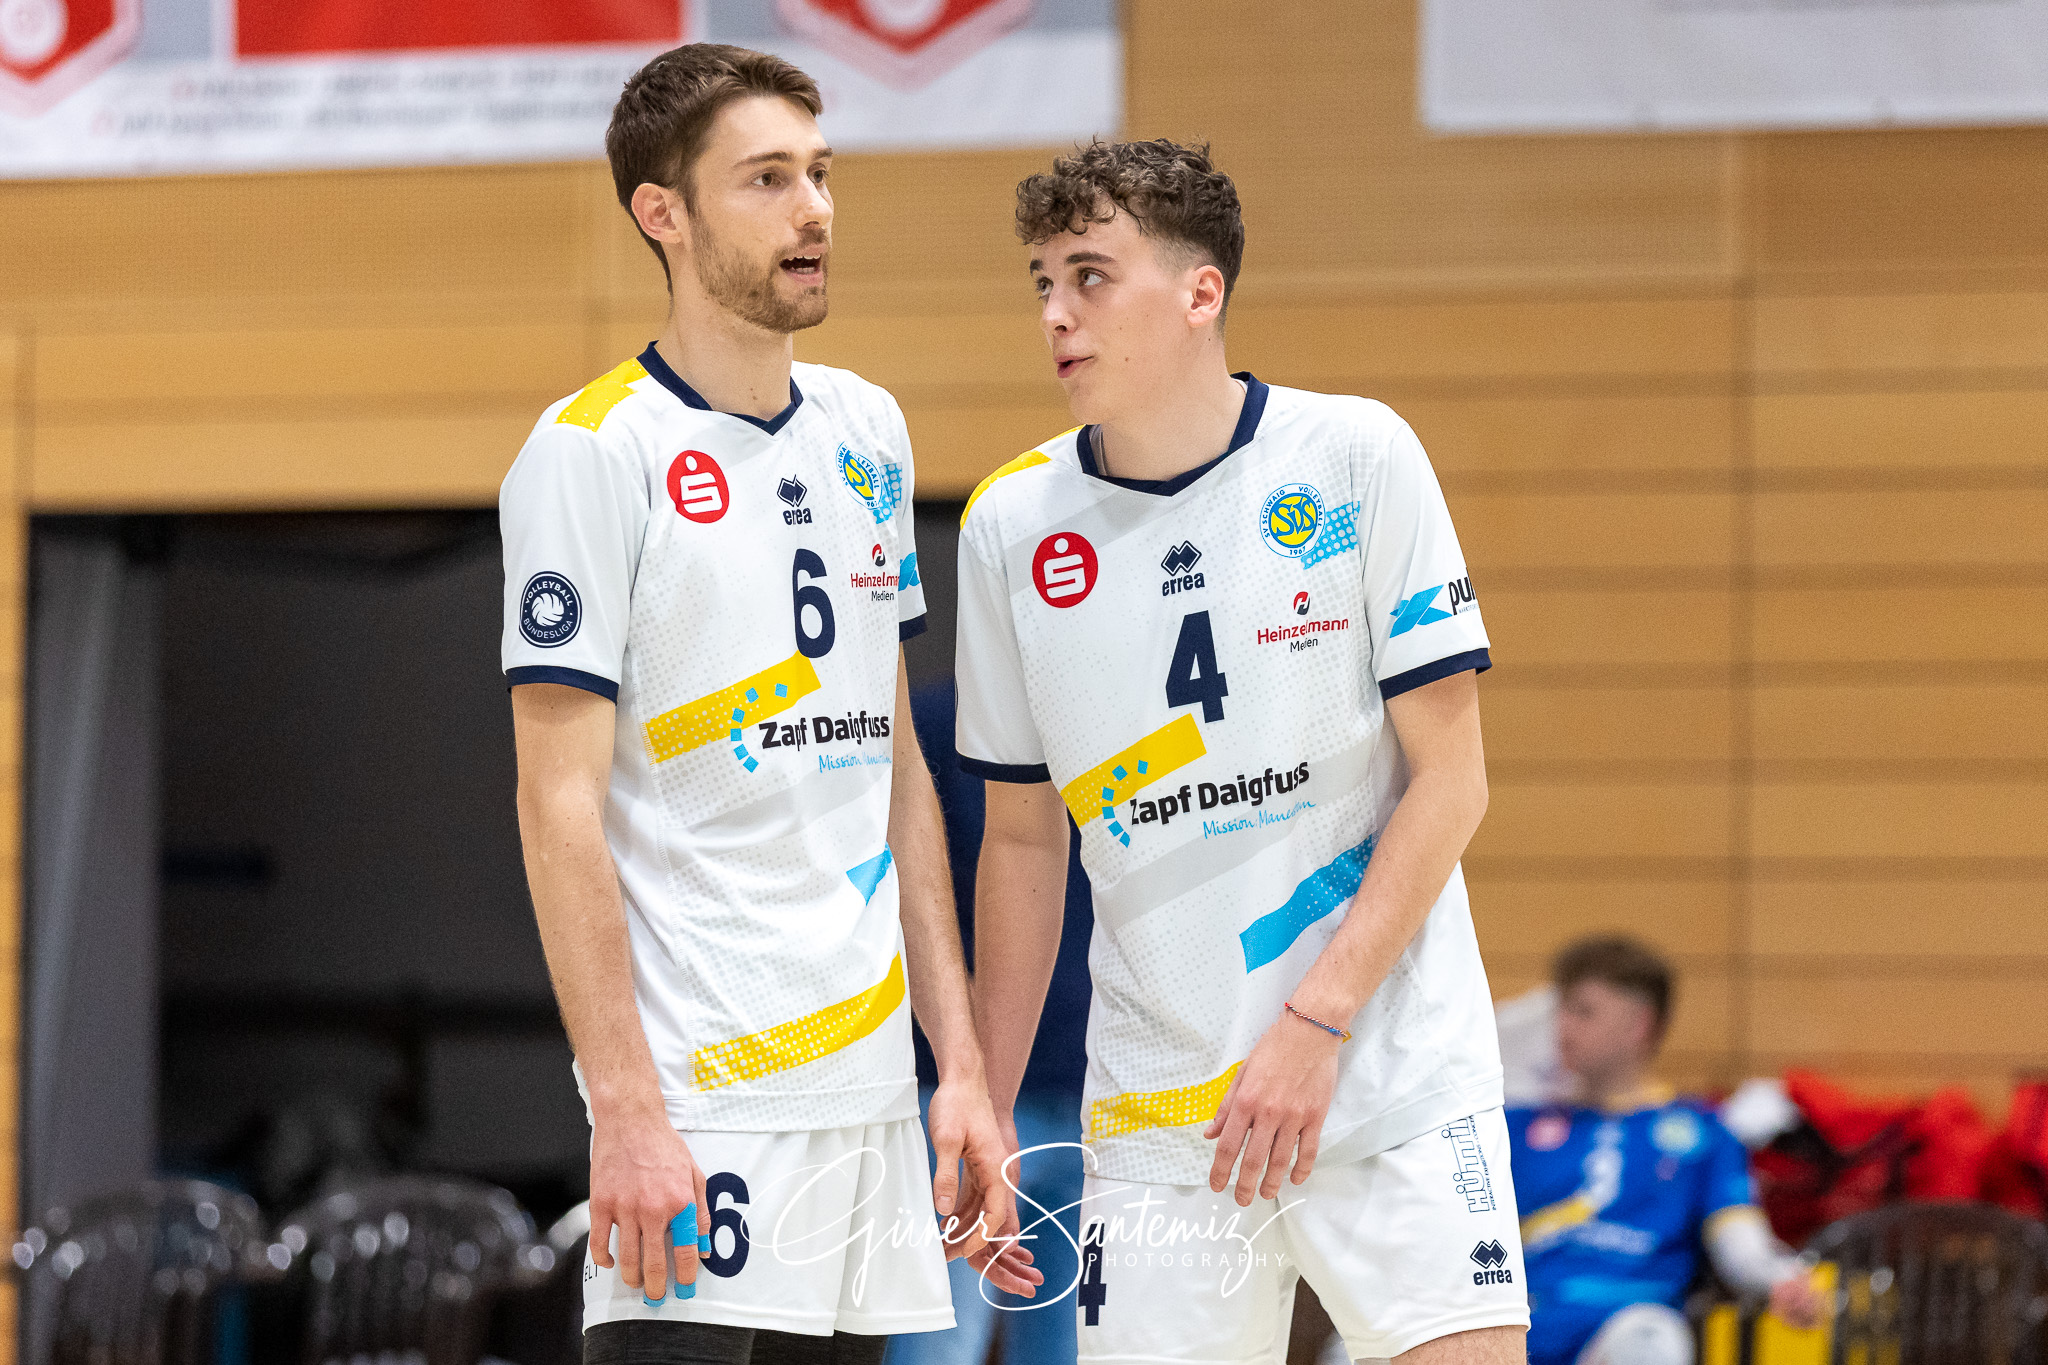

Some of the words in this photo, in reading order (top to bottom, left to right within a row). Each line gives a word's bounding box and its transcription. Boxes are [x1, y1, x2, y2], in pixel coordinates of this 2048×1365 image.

[1262, 489, 1286, 525] SCHWAIG
[1298, 486, 1323, 527] VOLLEYBALL
[525, 580, 574, 607] VOLLEYBALL
[1161, 572, 1206, 597] errea
[792, 548, 836, 659] 6
[523, 617, 573, 639] BUNDESLIGA
[1257, 618, 1349, 645] Heinzelmann
[1165, 609, 1229, 724] 4
[758, 717, 807, 752] Zapf
[812, 710, 890, 746] Daigfuss
[818, 752, 862, 774] Mission
[1129, 784, 1192, 826] Zapf
[1197, 761, 1310, 811] Daigfuss
[1202, 819, 1255, 840] Mission
[700, 1171, 750, 1279] 6
[1472, 1269, 1513, 1286] errea
